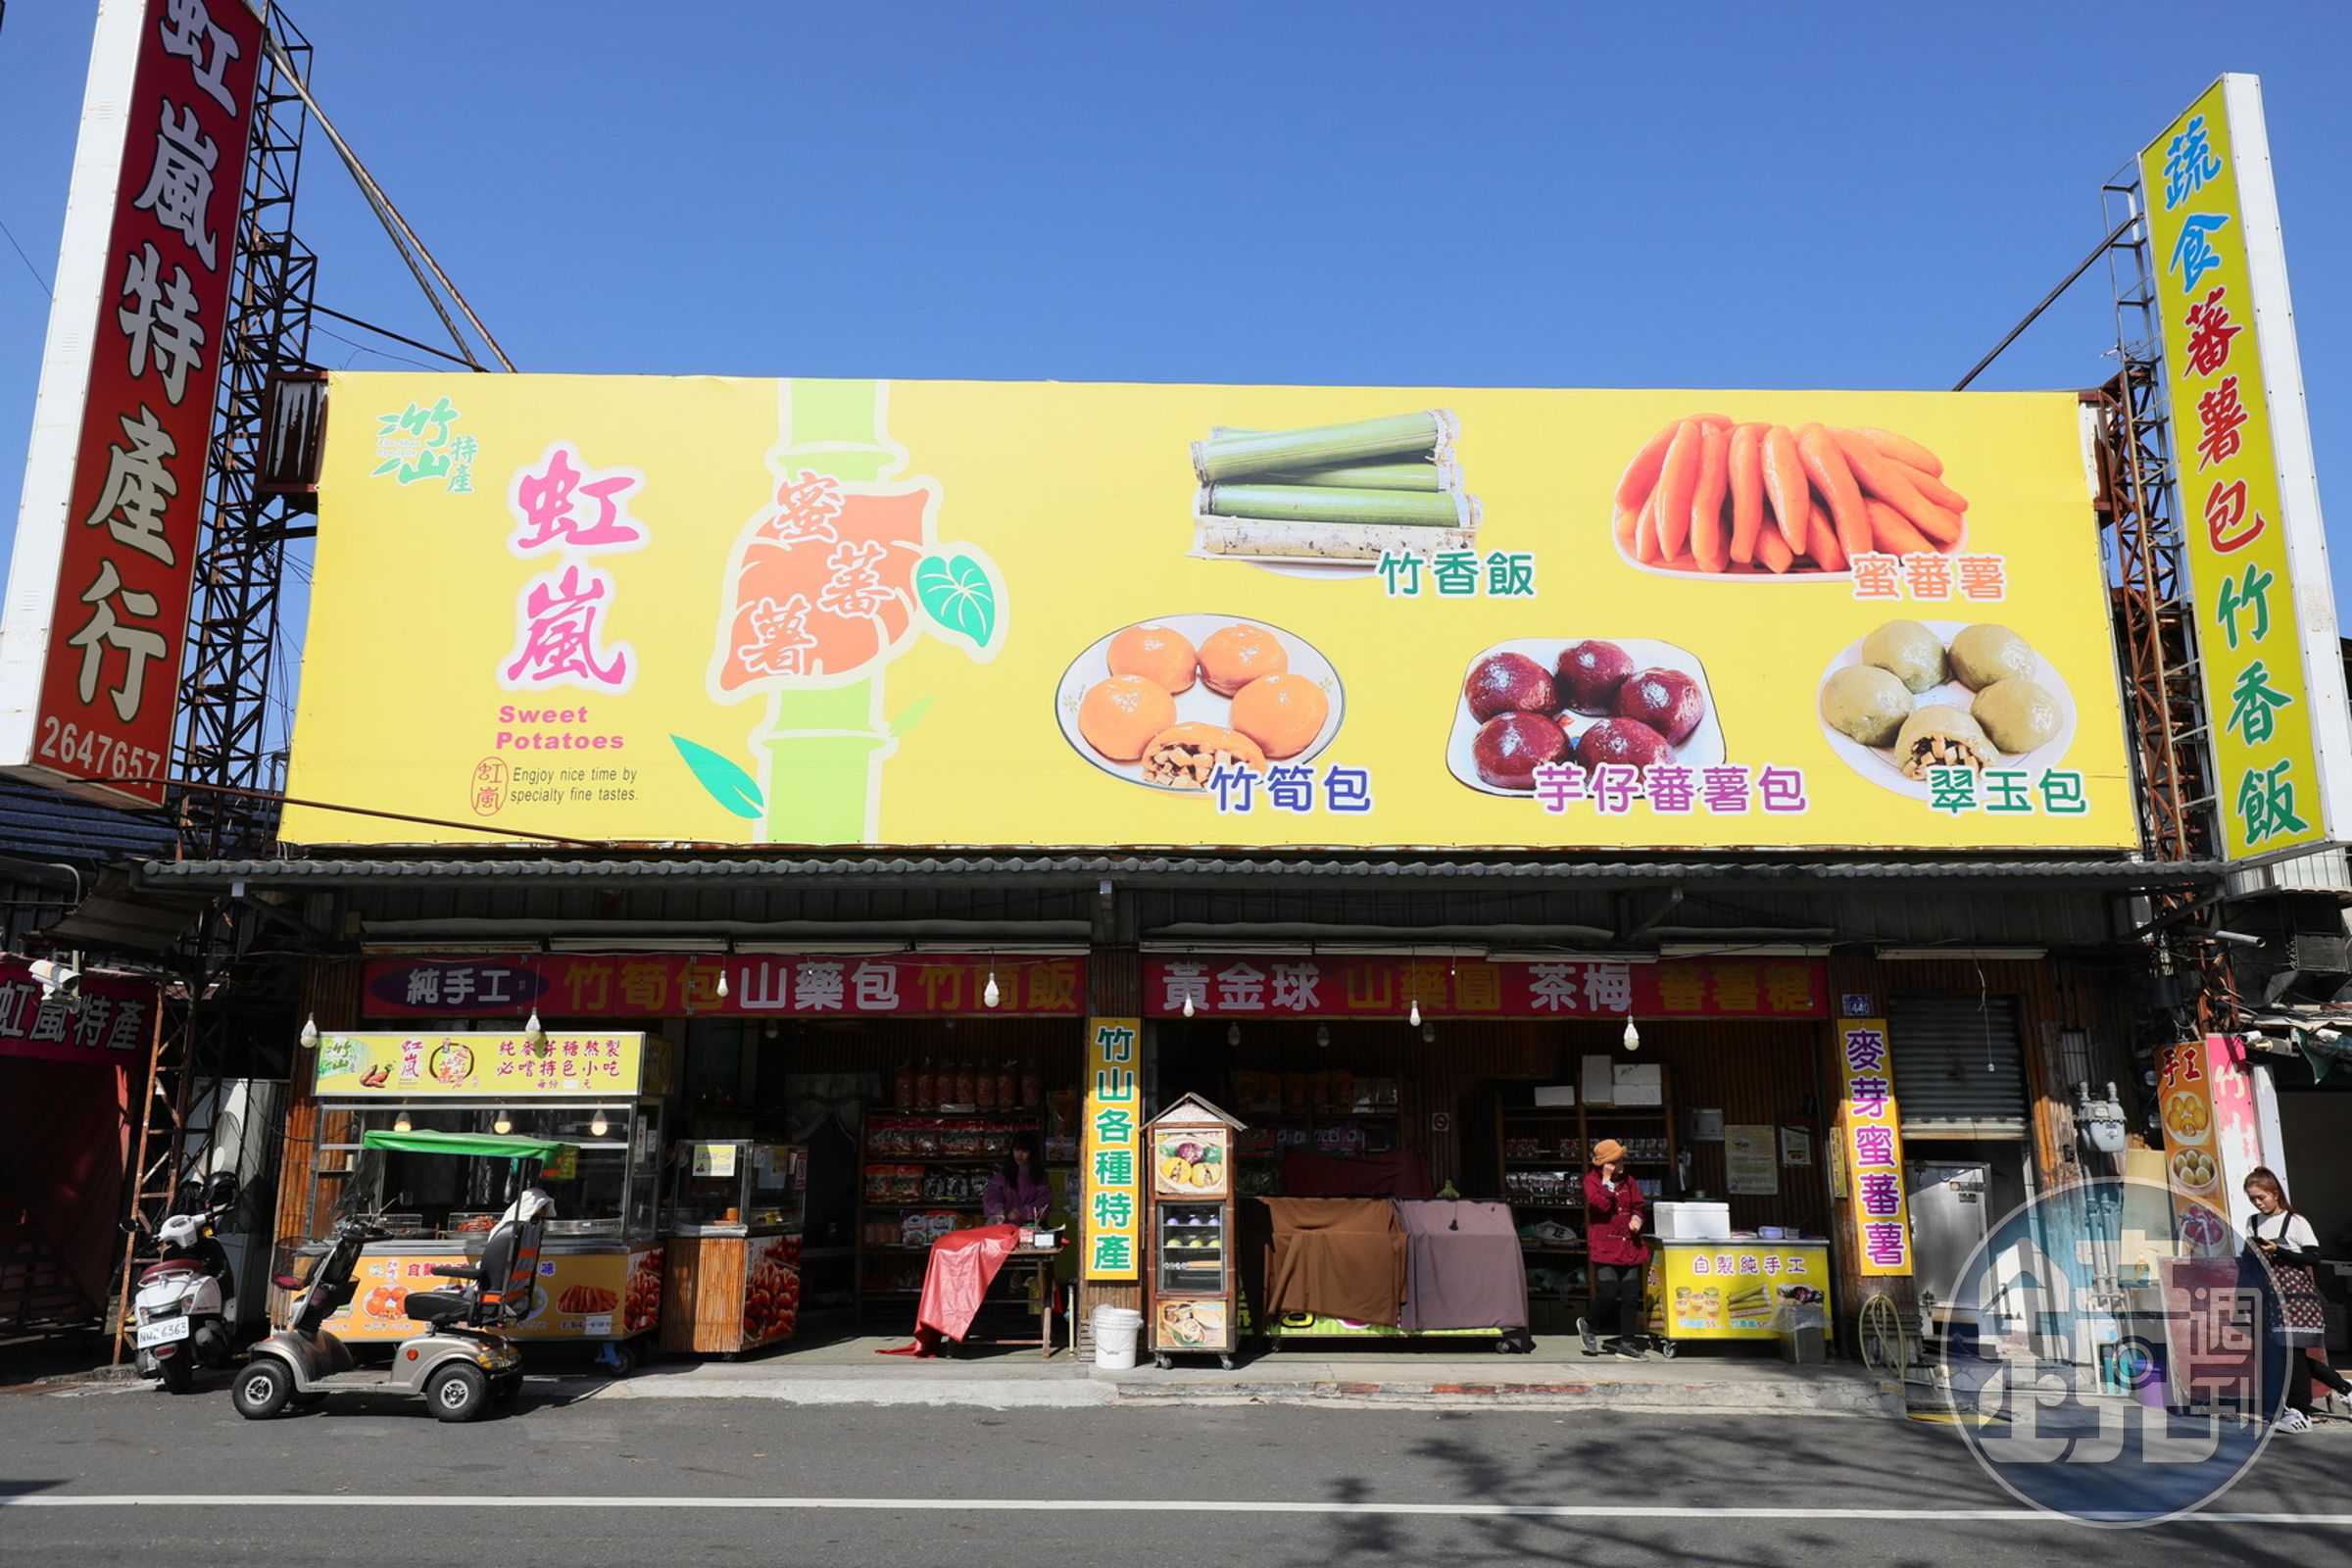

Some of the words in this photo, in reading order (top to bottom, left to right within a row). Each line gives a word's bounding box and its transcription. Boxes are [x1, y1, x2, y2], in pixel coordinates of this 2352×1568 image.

[68, 0, 241, 723] 虹嵐特產行
[448, 434, 478, 493] 特產
[2162, 116, 2309, 845] 蔬食蕃薯包竹香飯
[508, 450, 640, 685] 虹嵐
[1378, 551, 1535, 596] 竹香飯
[1853, 556, 2004, 599] 蜜蕃薯
[498, 705, 588, 723] Sweet
[40, 716, 161, 788] 2647657
[496, 731, 624, 750] Potatoes
[511, 788, 564, 805] specialty
[570, 787, 593, 801] fine
[599, 788, 639, 801] tastes.
[514, 767, 554, 784] Engjoy
[560, 768, 585, 781] nice
[591, 767, 616, 781] time
[622, 767, 638, 784] by
[1211, 765, 1371, 812] 竹筍包
[1537, 766, 1806, 813] 芋仔蕃薯包
[1931, 768, 2086, 813] 翠玉包
[407, 967, 511, 1005] 純手工
[564, 961, 725, 1010] 竹筍包
[740, 961, 900, 1010] 山藥包
[1162, 962, 1320, 1011] 黃金球
[1529, 962, 1632, 1011] 茶梅
[2161, 1046, 2202, 1089] 手工
[1093, 1025, 1135, 1272] 竹山各種特產
[1845, 1029, 1904, 1266] 麥芽蜜蕃薯
[1693, 1255, 1807, 1275] 自製純手工
